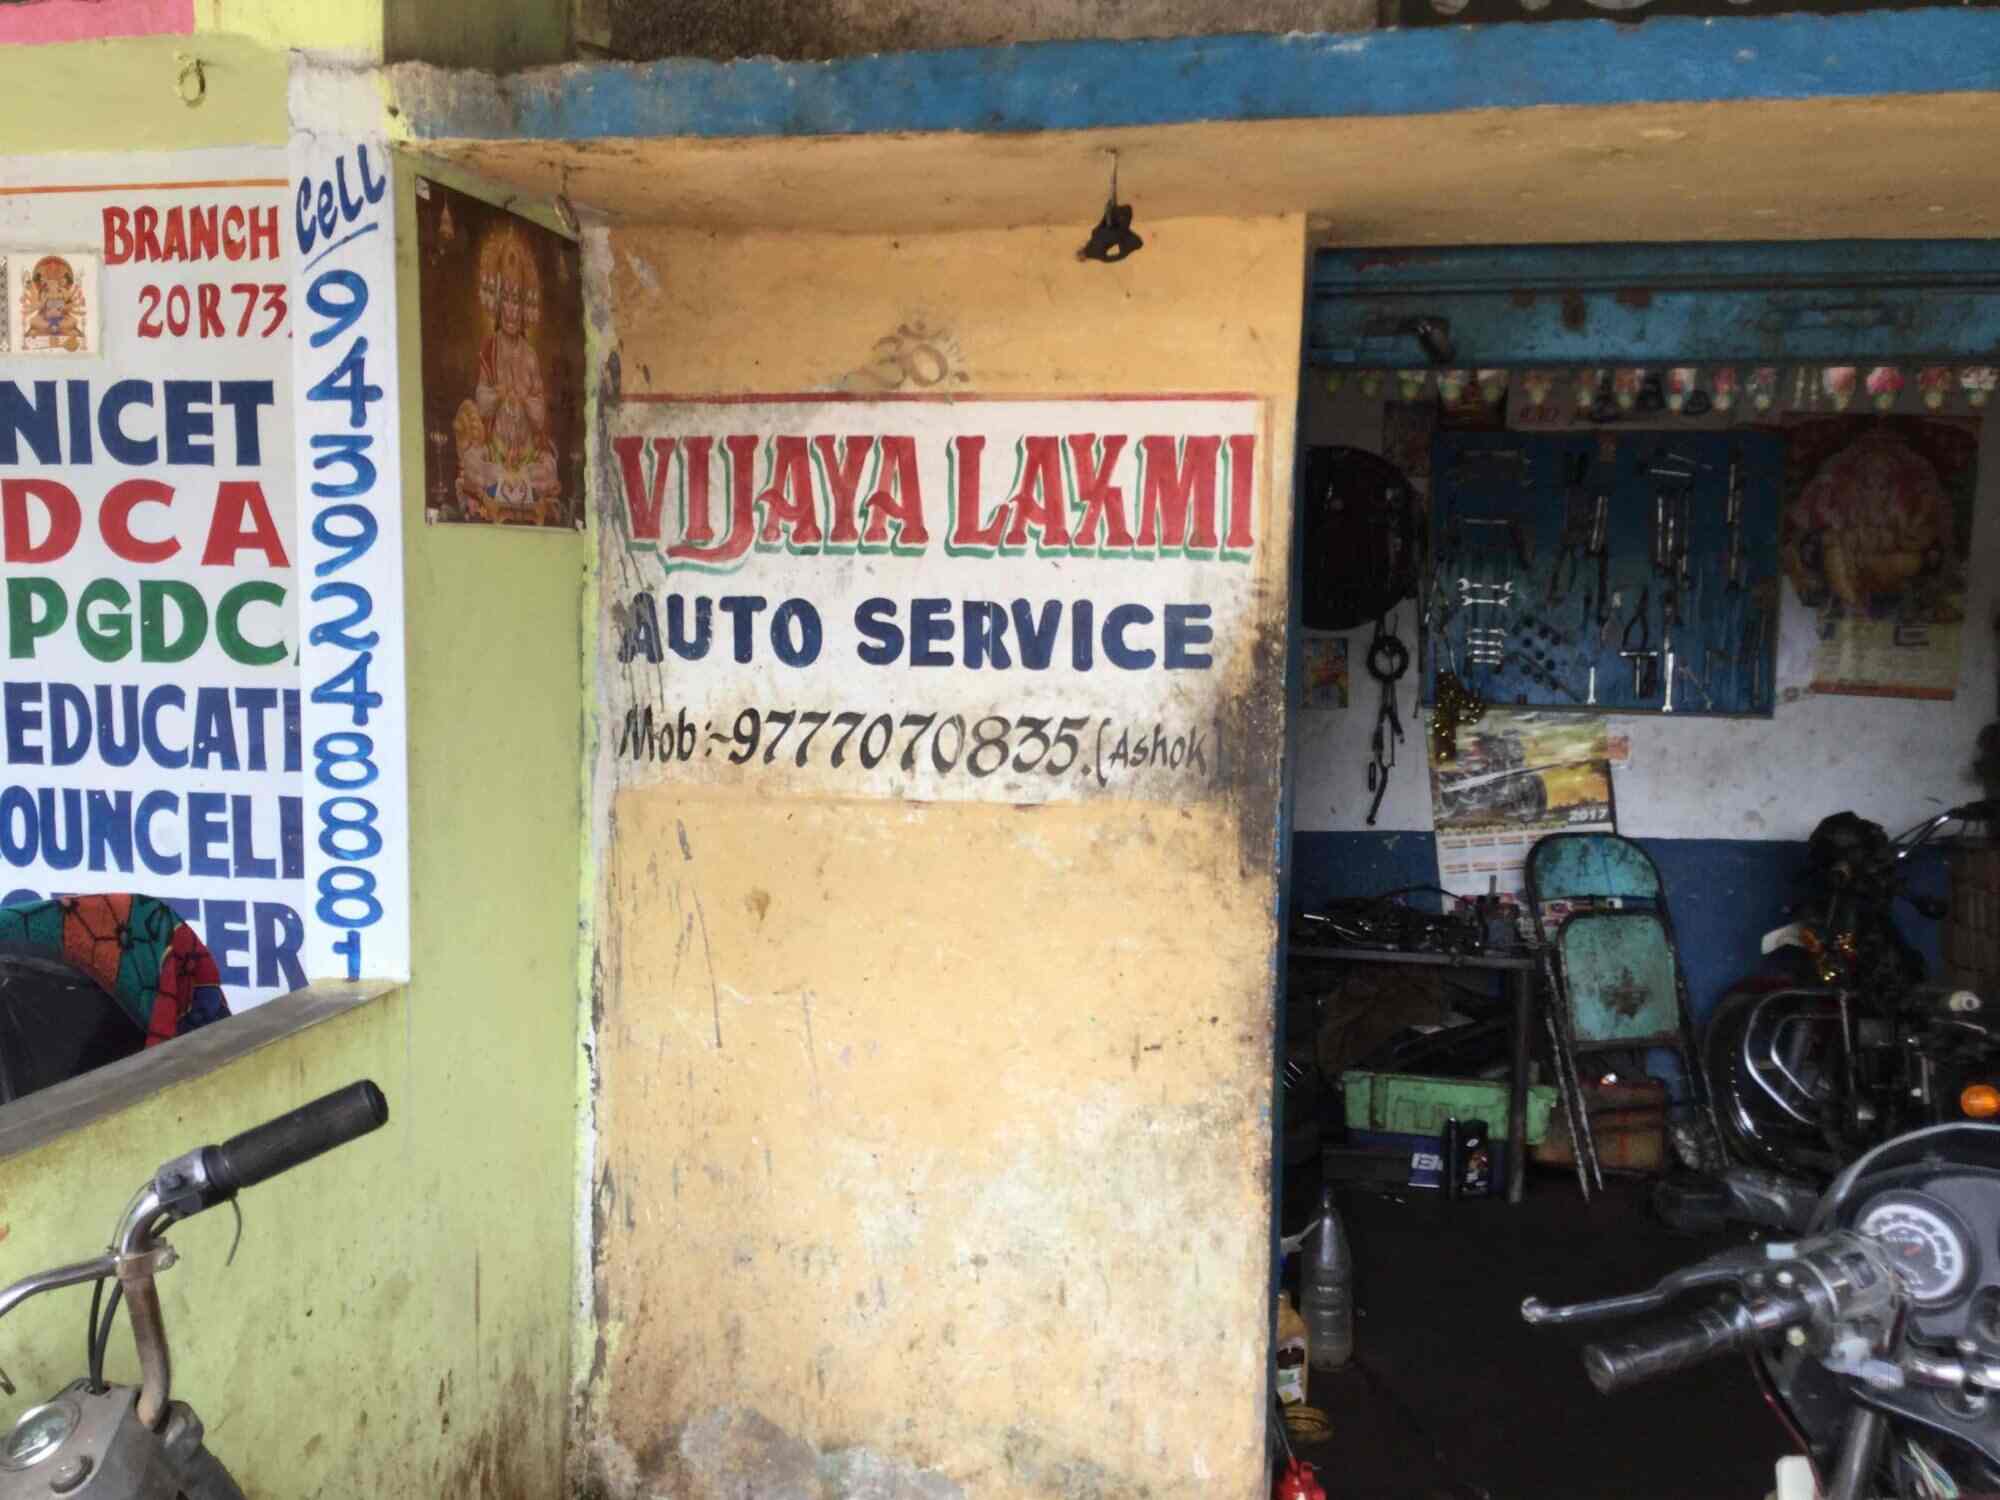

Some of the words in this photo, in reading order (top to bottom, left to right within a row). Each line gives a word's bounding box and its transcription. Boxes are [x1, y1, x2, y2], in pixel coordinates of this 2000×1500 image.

[102, 205, 280, 265] BRANCH
[0, 379, 274, 466] NICET
[0, 478, 290, 567] DCA
[611, 434, 929, 575] VIJAYA
[944, 433, 1255, 562] LAXMI
[6, 577, 300, 666] PGDC
[617, 593, 823, 668] AUTO
[855, 597, 1213, 671] SERVICE
[3, 682, 303, 772] EDUCATI
[0, 785, 304, 879] OUNCELI
[1568, 808, 1609, 822] 2017
